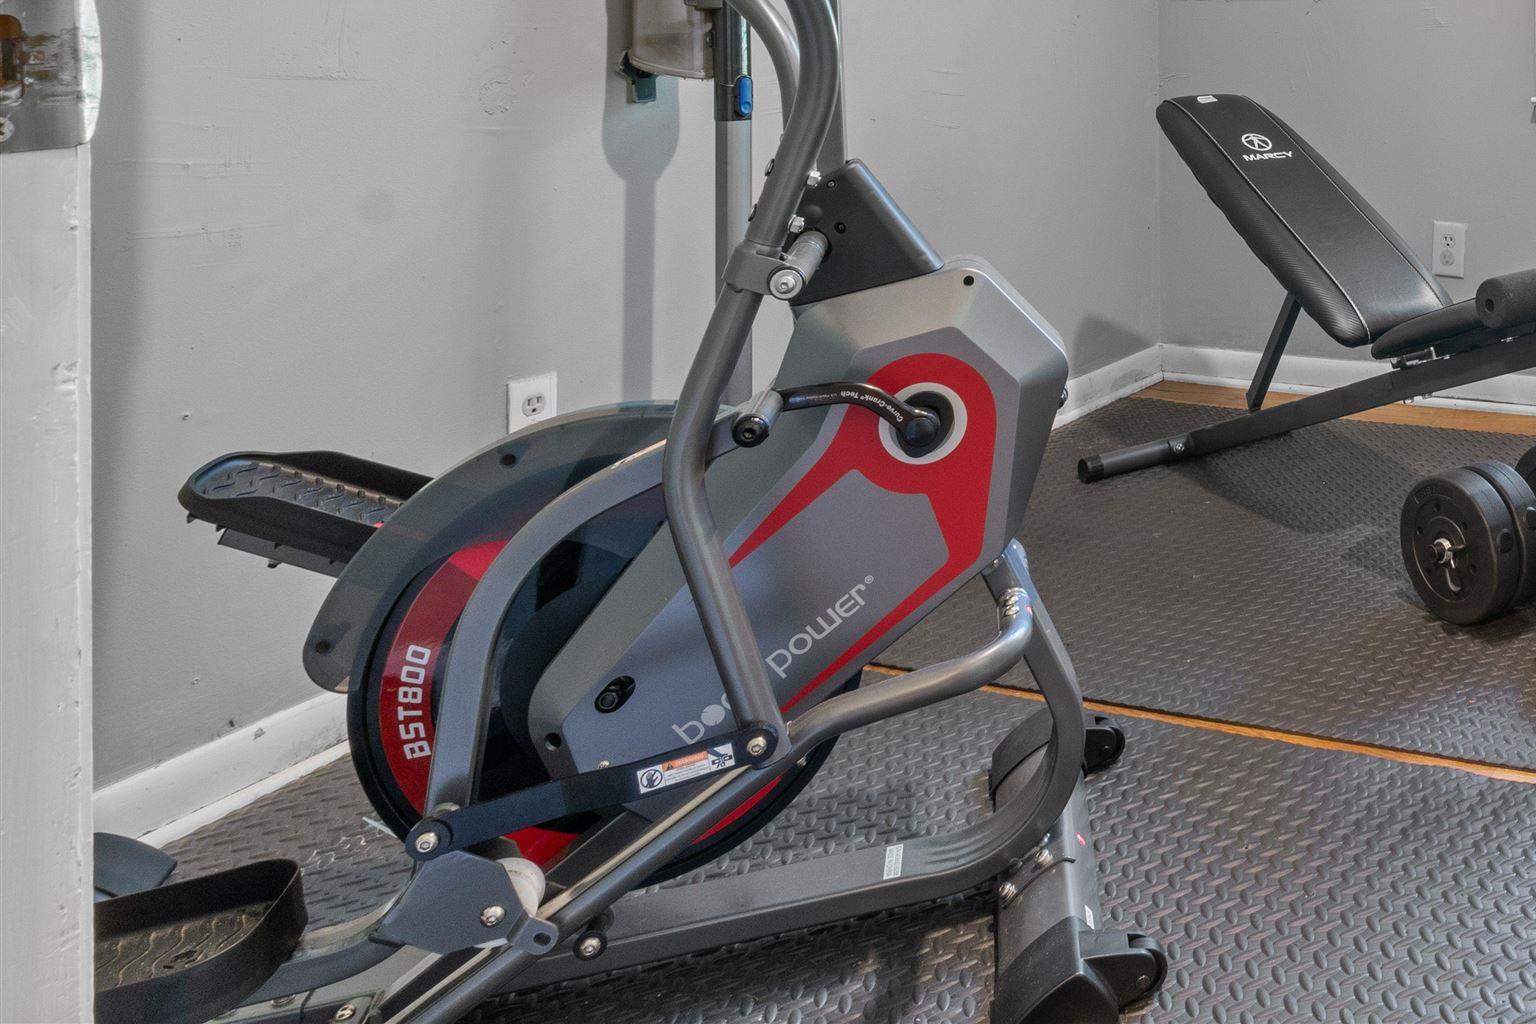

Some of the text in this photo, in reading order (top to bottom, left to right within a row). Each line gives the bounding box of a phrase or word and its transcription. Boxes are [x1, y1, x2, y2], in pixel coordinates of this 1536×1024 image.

[1242, 151, 1293, 162] MARCY
[840, 390, 859, 400] Tech
[397, 644, 432, 760] BST800
